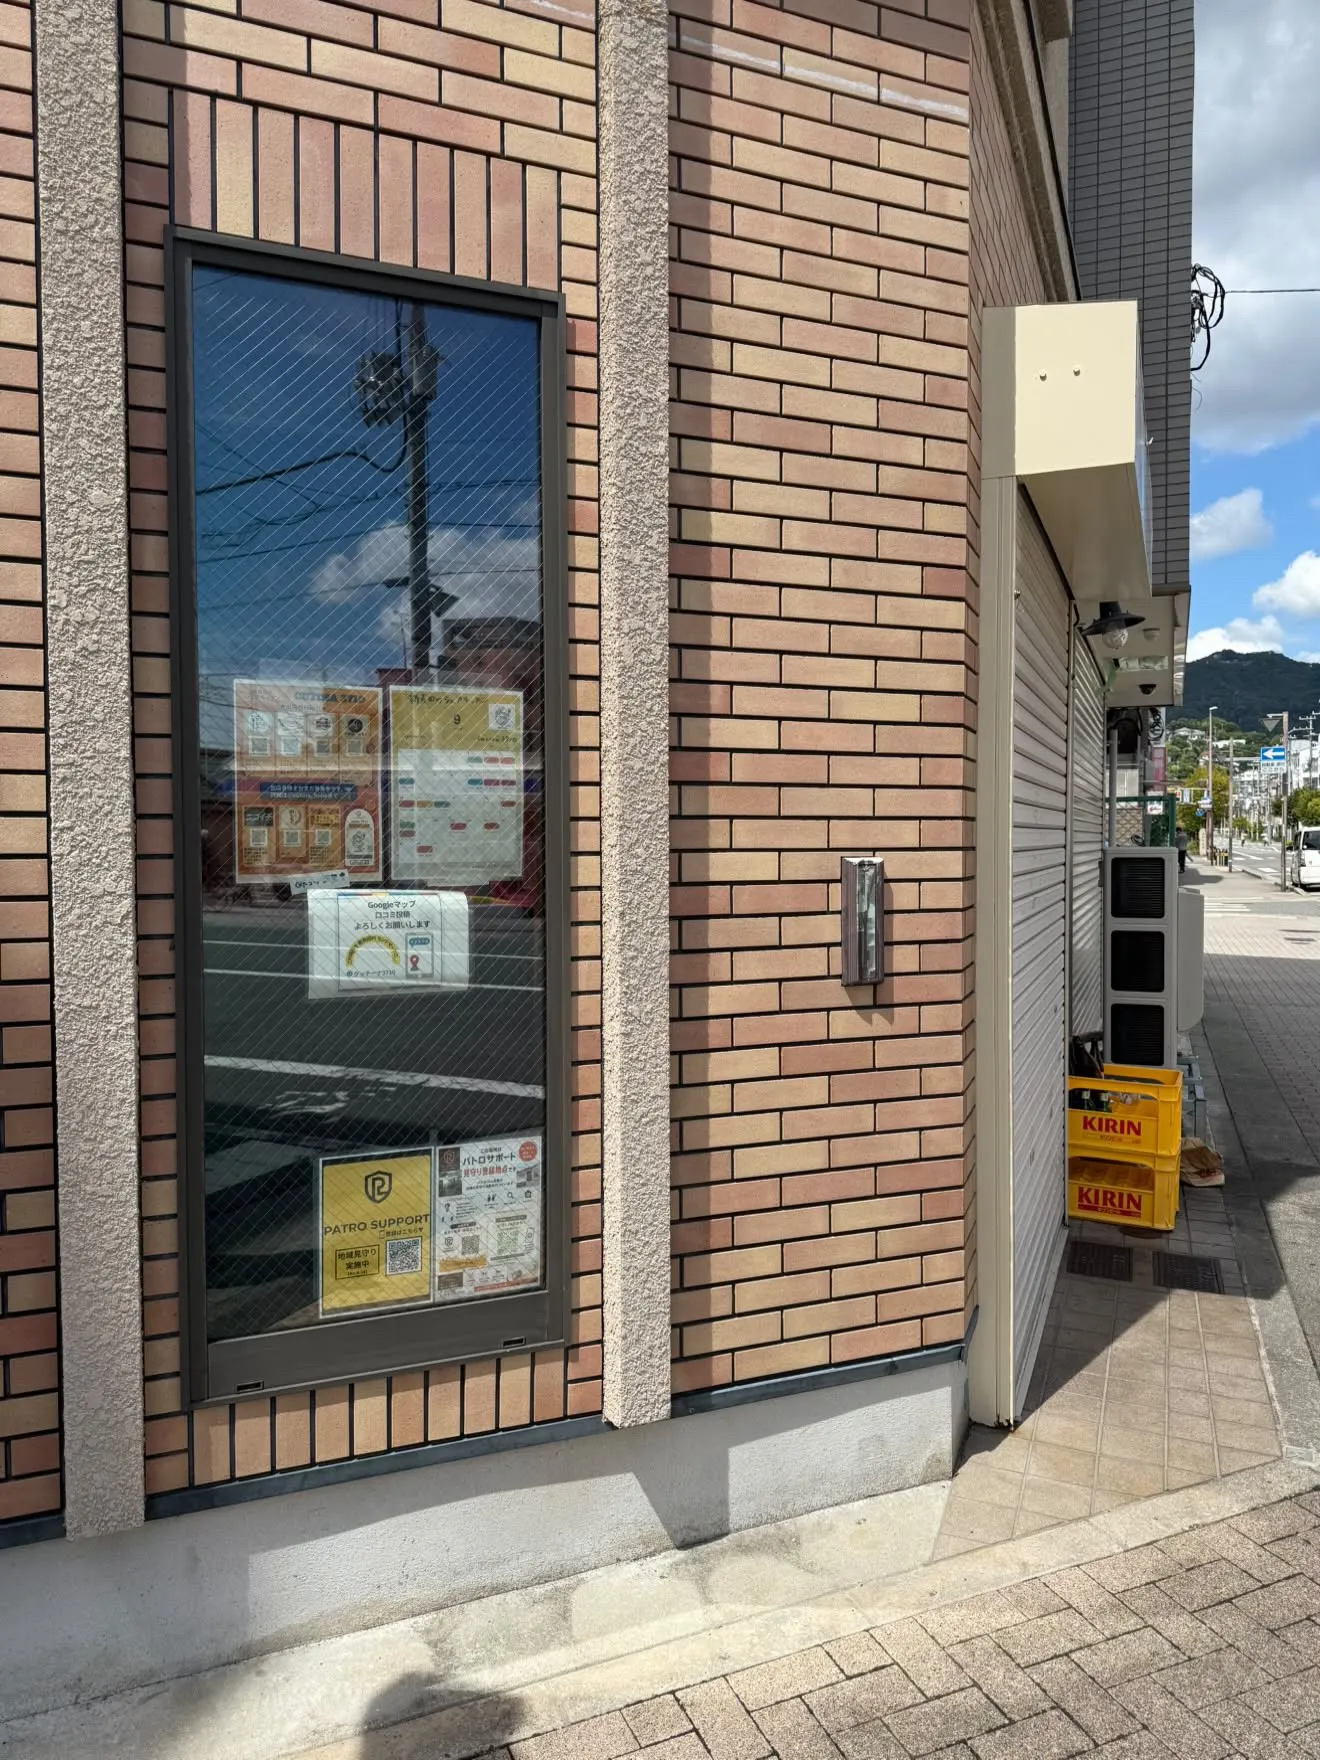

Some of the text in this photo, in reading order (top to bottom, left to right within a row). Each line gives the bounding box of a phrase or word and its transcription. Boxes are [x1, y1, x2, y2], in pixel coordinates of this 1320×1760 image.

[368, 900, 416, 909] Googleマップ
[375, 910, 411, 919] 口コミ投稿
[354, 920, 431, 930] よろしくお願いします
[1082, 1115, 1142, 1137] KIRIN
[1077, 1185, 1143, 1211] KIRIN
[323, 1214, 430, 1235] PATRO SUPPORT
